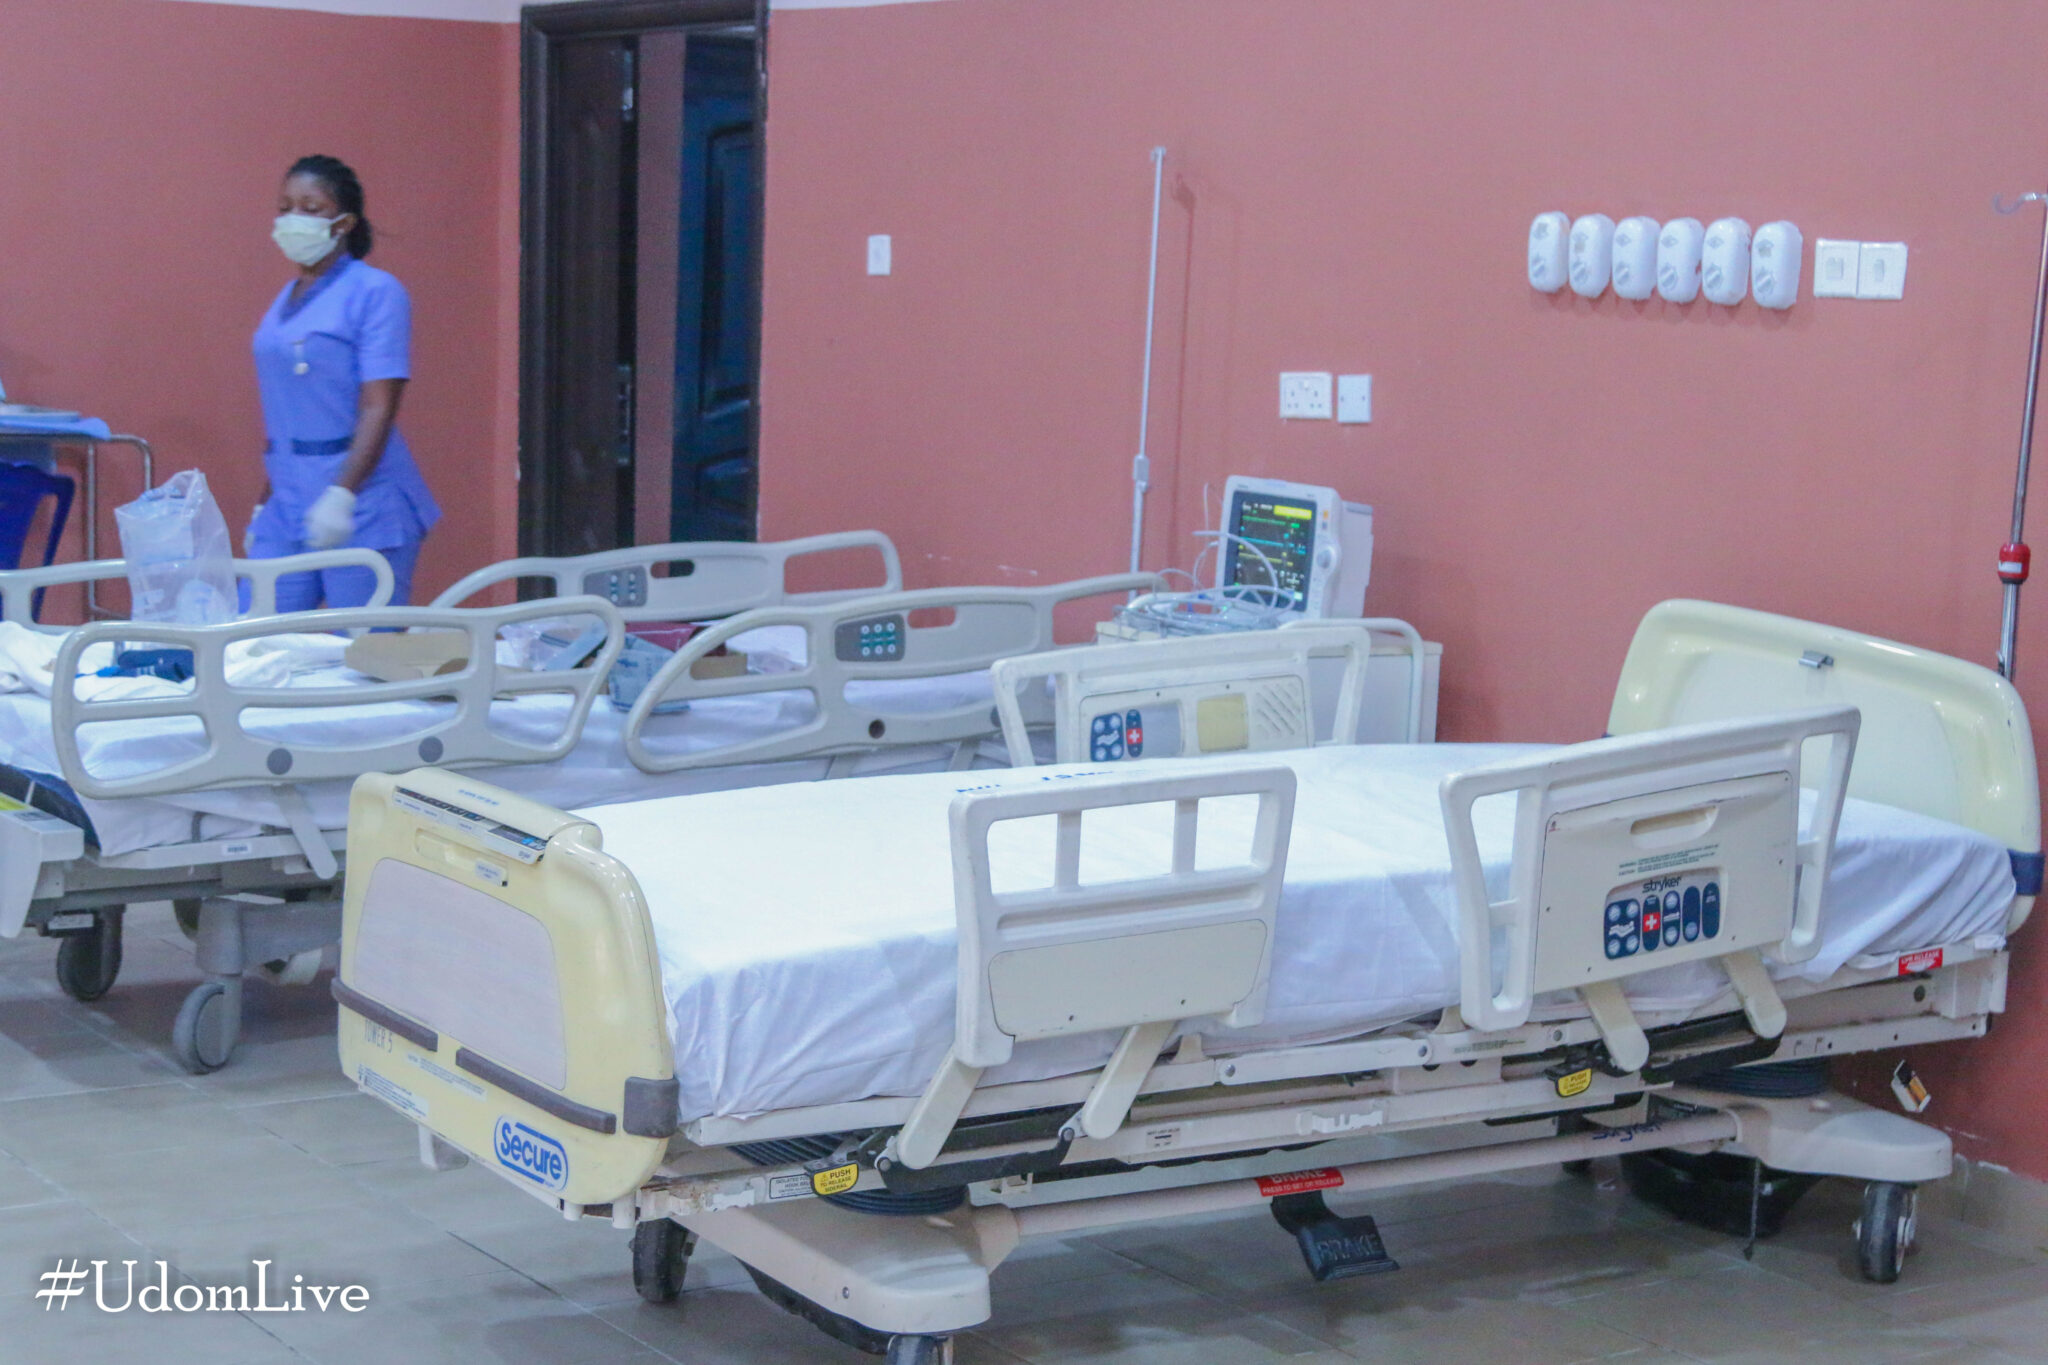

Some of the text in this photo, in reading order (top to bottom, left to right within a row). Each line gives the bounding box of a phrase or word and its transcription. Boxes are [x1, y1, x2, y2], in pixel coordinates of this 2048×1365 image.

[1642, 876, 1683, 894] stryker
[500, 1121, 563, 1181] Secure
[829, 1176, 853, 1185] RELEASE
[830, 1169, 851, 1179] PUSH
[1317, 1233, 1379, 1262] BRAKE
